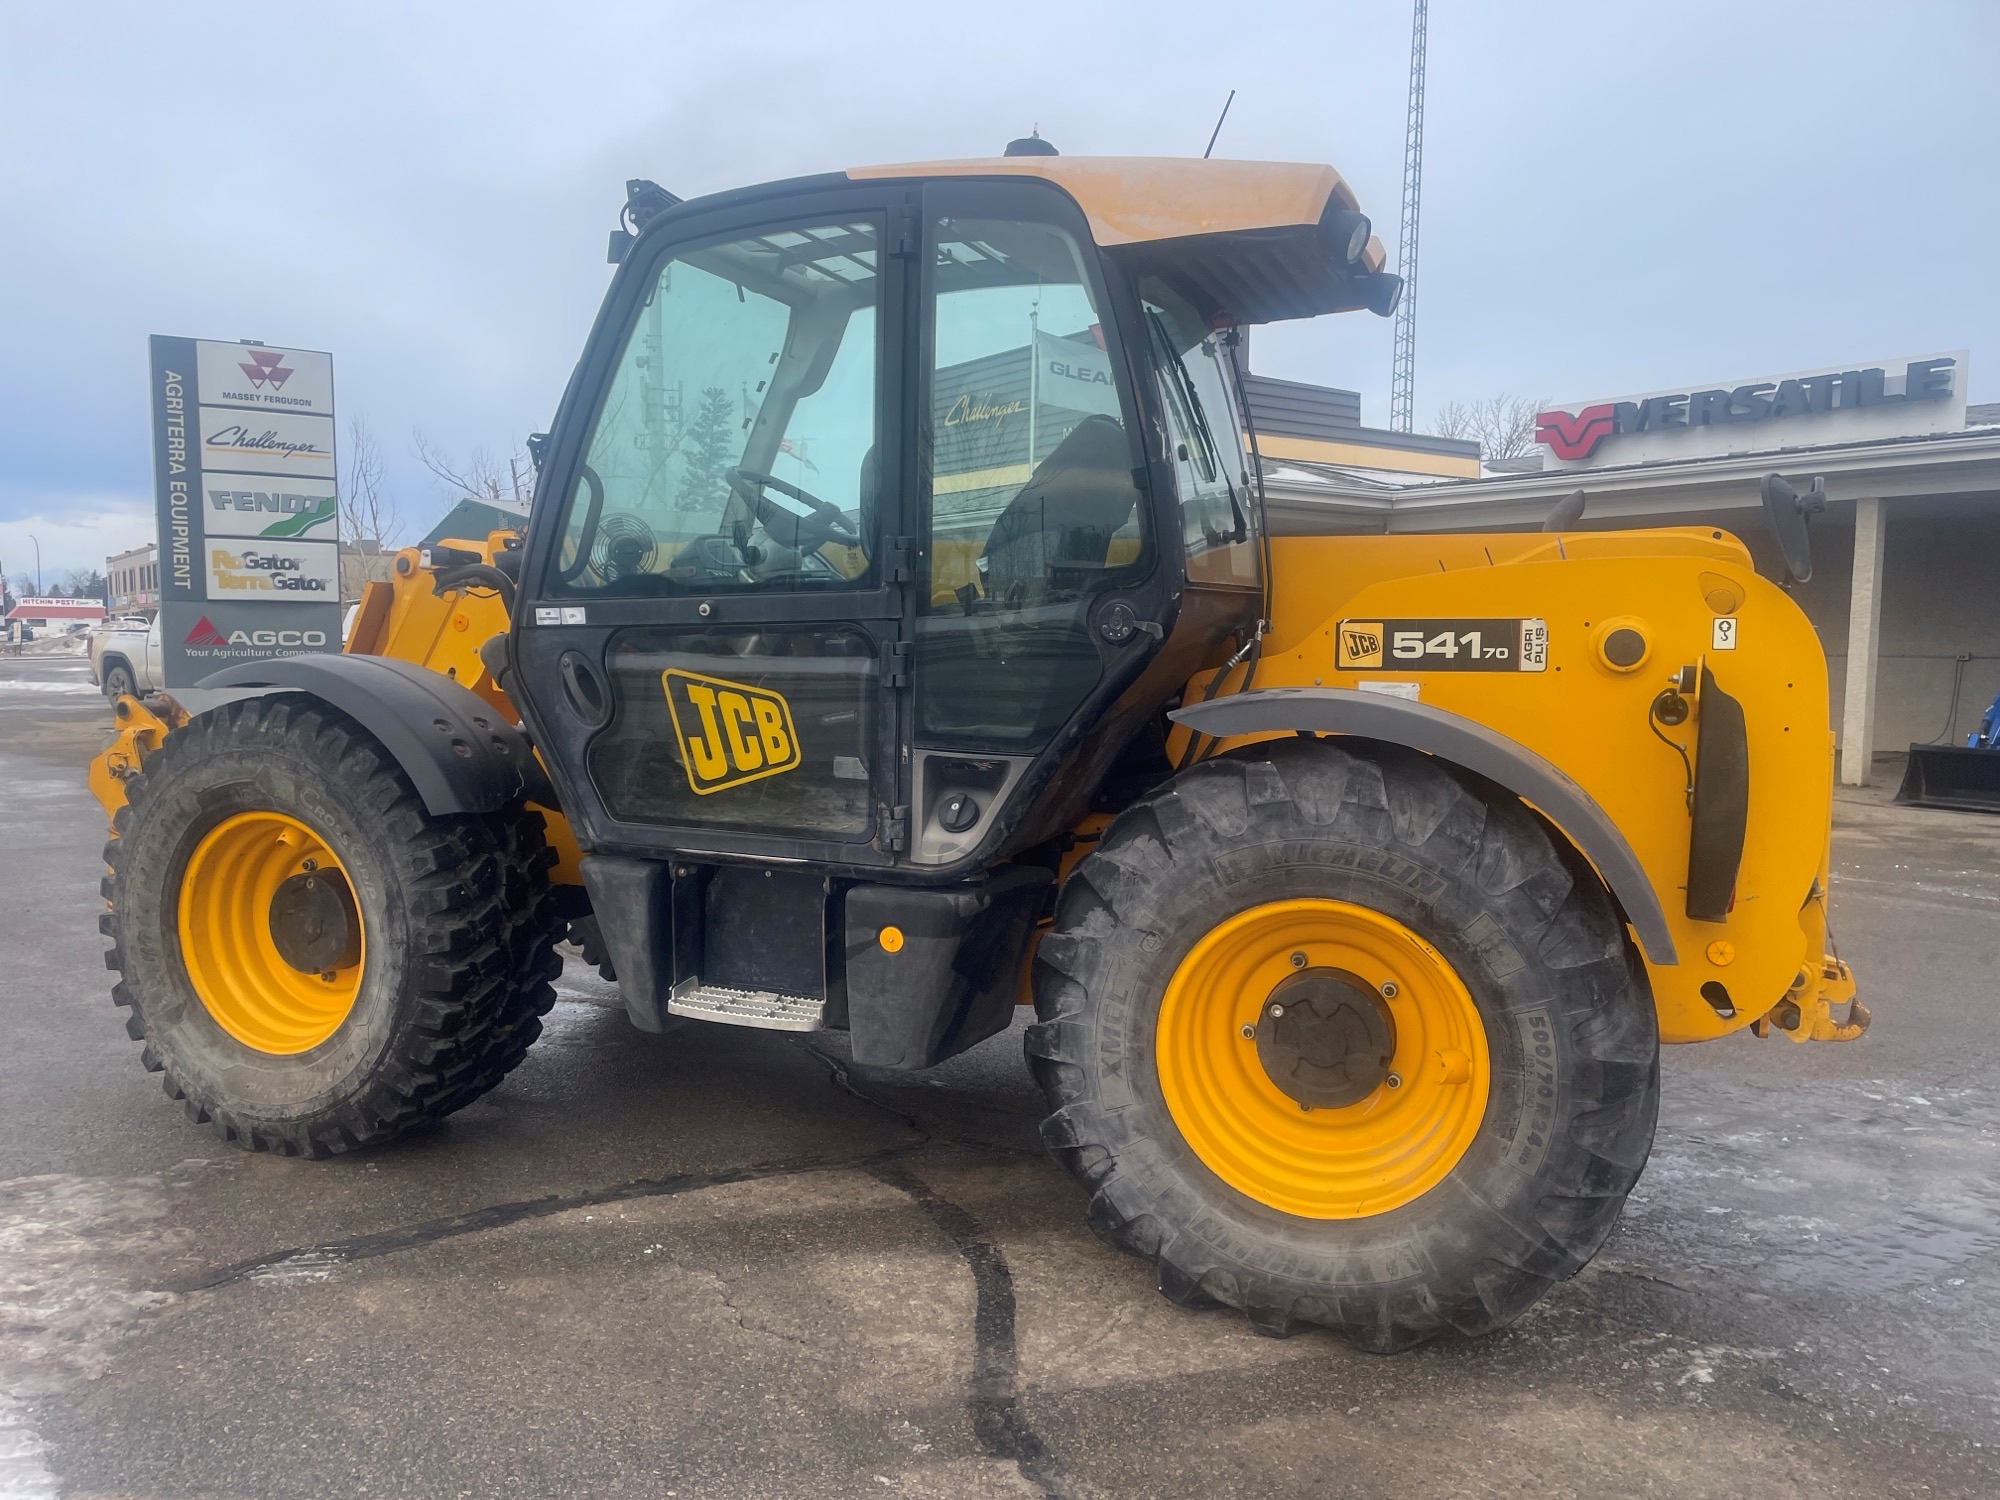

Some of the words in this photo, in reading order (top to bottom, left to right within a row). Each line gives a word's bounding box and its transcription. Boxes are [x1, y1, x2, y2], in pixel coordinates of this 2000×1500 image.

[222, 392, 261, 402] MASSEY
[264, 395, 312, 407] FERGUSON
[1613, 357, 1956, 434] VERSATILE
[165, 370, 187, 475] AGRITERRA
[206, 426, 331, 458] Challenger
[208, 490, 329, 514] FENDT
[170, 481, 191, 590] EQUIPMENT
[212, 550, 304, 570] RoGator
[213, 570, 330, 591] TerraGator
[228, 630, 326, 646] AGCO
[1349, 634, 1378, 657] JCB
[1393, 631, 1481, 659] 541
[1483, 647, 1509, 659] 70
[1524, 628, 1534, 662] AGRI
[1535, 627, 1544, 663] PLUS
[185, 648, 209, 657] Your
[212, 648, 272, 659] Agriculture
[686, 683, 791, 780] JCB
